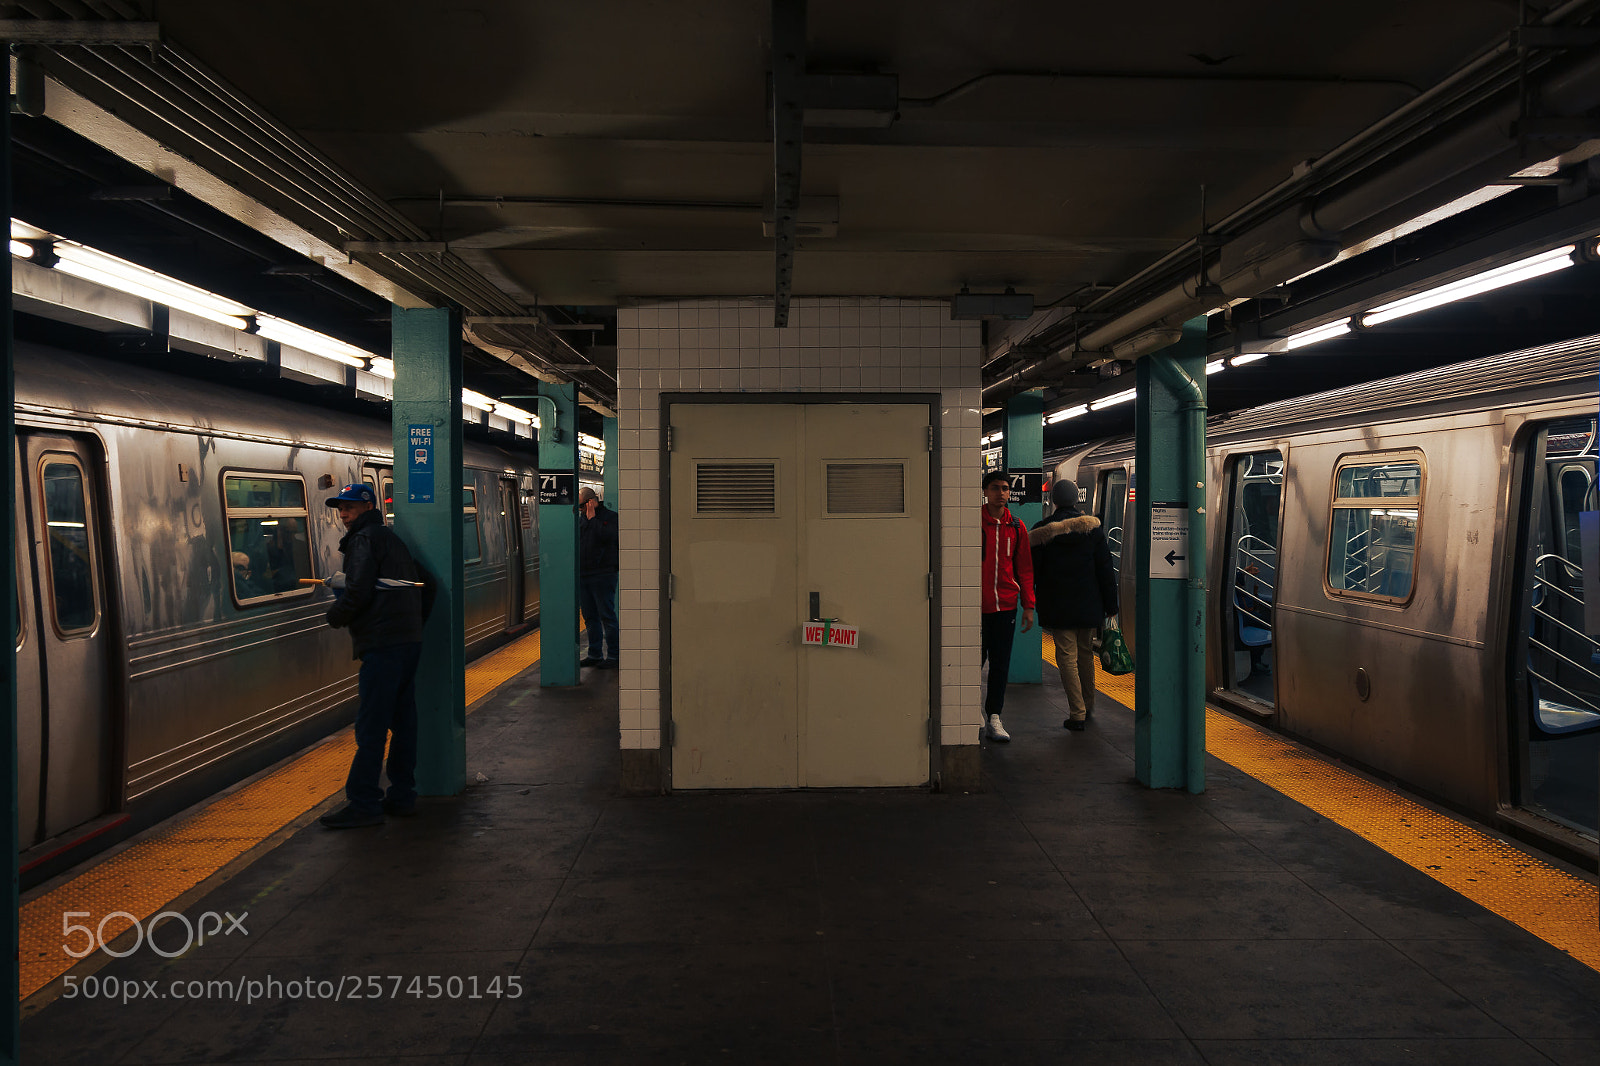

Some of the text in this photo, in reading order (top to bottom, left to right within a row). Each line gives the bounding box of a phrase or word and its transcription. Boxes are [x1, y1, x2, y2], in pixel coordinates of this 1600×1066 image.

[410, 428, 431, 437] FREE
[410, 437, 431, 445] WI-FI
[540, 475, 557, 490] 71
[1009, 474, 1026, 488] 71
[806, 626, 857, 646] WET PAINT
